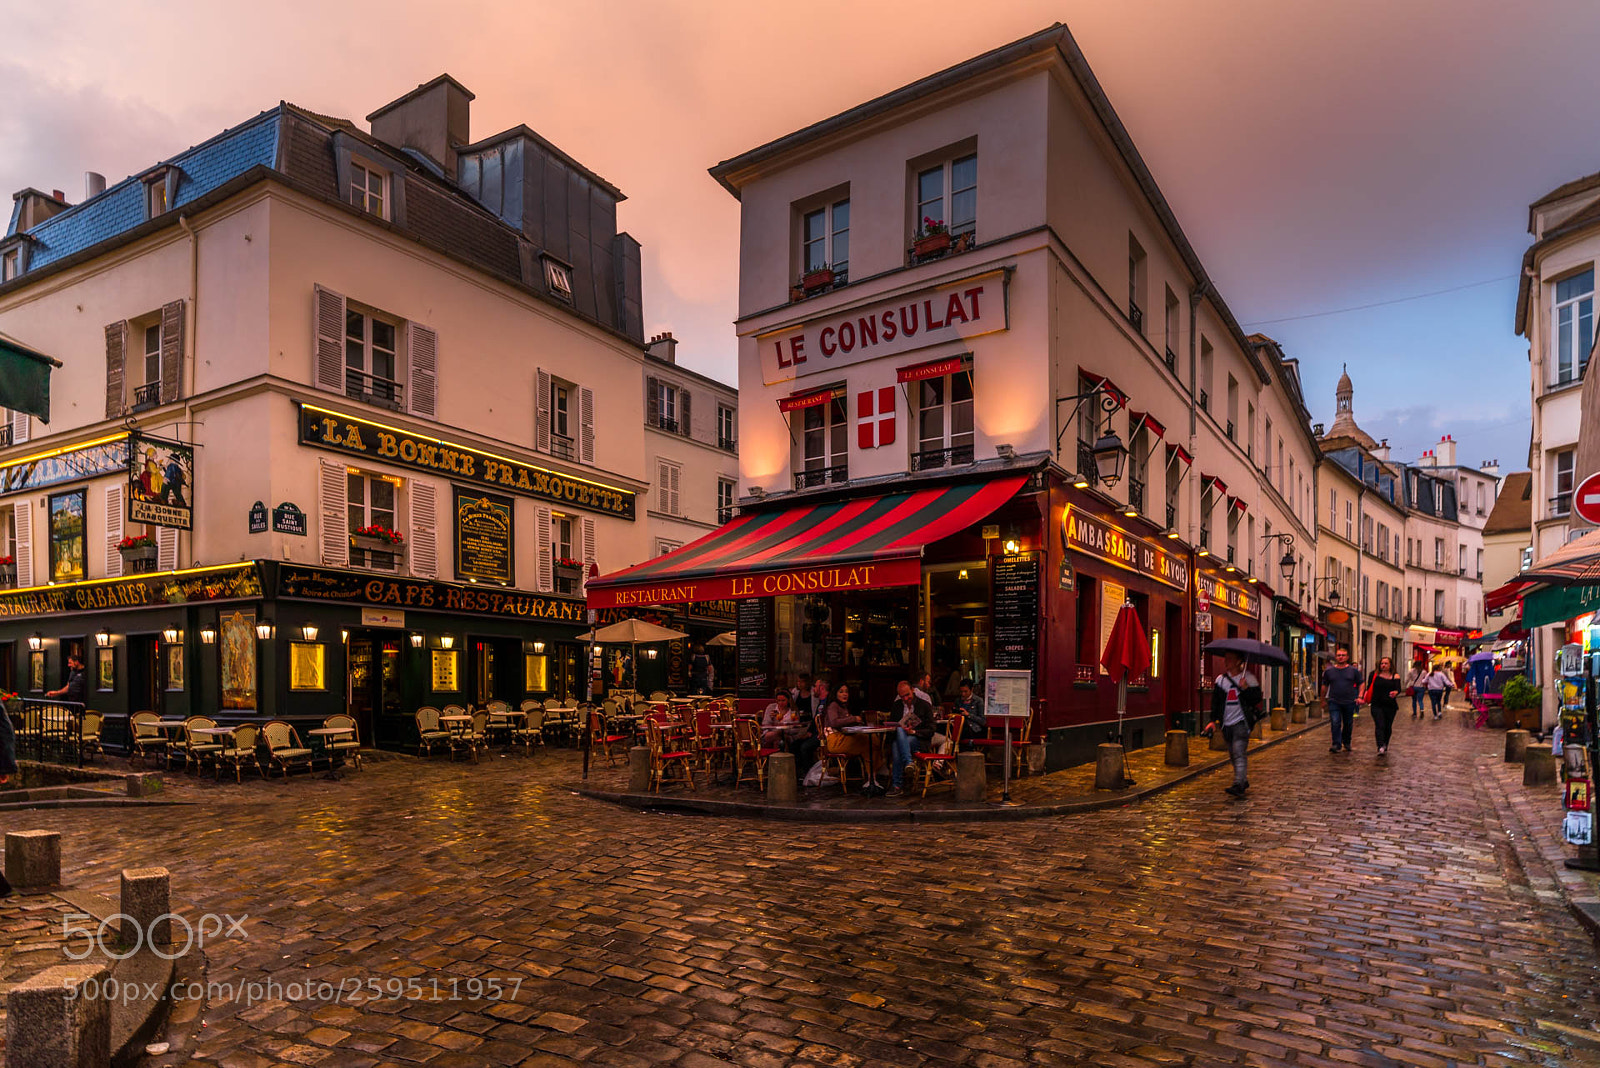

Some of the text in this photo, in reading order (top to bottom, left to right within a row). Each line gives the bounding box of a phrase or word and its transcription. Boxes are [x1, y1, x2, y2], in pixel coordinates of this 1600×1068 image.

[774, 286, 984, 370] LE CONSULAT
[915, 364, 952, 377] CONSULAT
[787, 395, 822, 409] RESTAURANT
[322, 418, 623, 511] LA BONNE FRANQUETTE
[135, 510, 188, 526] FRANQUETTE
[155, 506, 182, 517] BONNE
[277, 523, 302, 532] RUSTIQUE
[1067, 515, 1186, 584] AMBASSADE DE SAVOIE
[732, 566, 875, 596] LE CONSULAT
[75, 583, 147, 609] CABARET
[365, 579, 586, 621] CAFÉ RESTAURANT
[616, 586, 697, 604] RESTAURANT
[1231, 590, 1237, 605] LE
